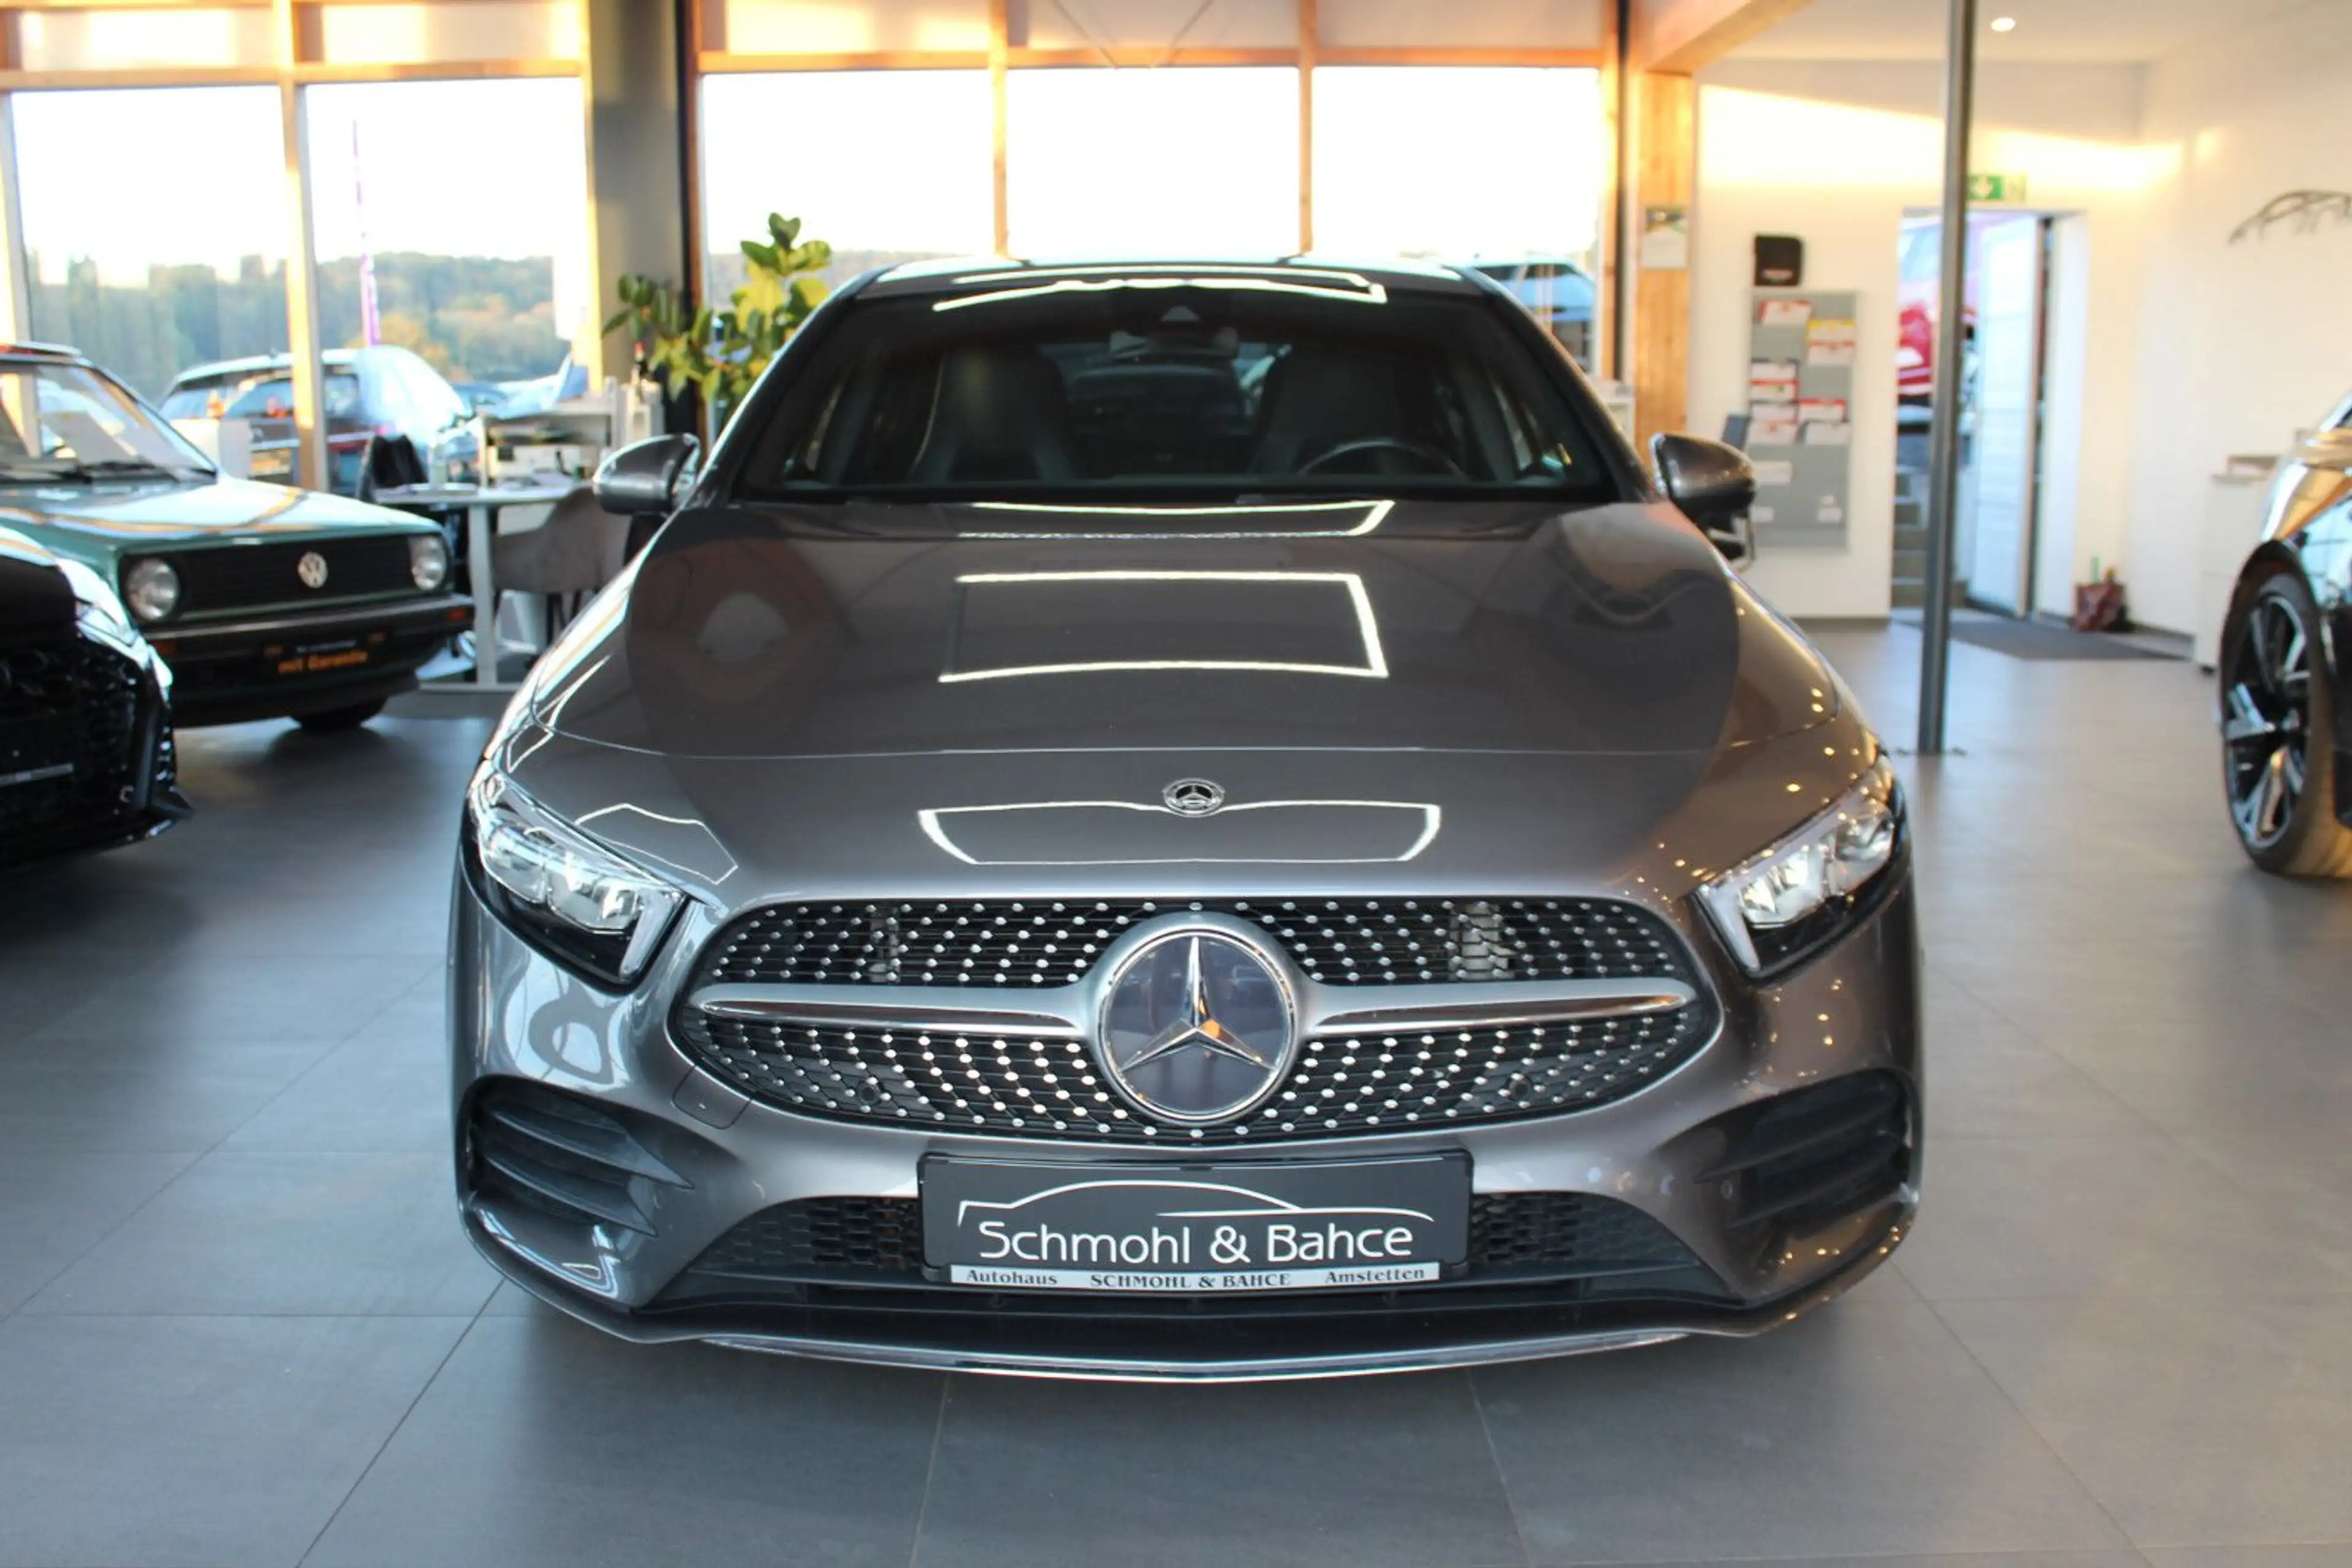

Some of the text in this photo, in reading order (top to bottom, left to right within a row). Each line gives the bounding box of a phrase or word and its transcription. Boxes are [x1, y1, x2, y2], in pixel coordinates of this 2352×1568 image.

[979, 1221, 1412, 1264] Schmohl & Bahce
[966, 1267, 1425, 1288] Autohaus SCHMOHL & BAHCE Amstetten
